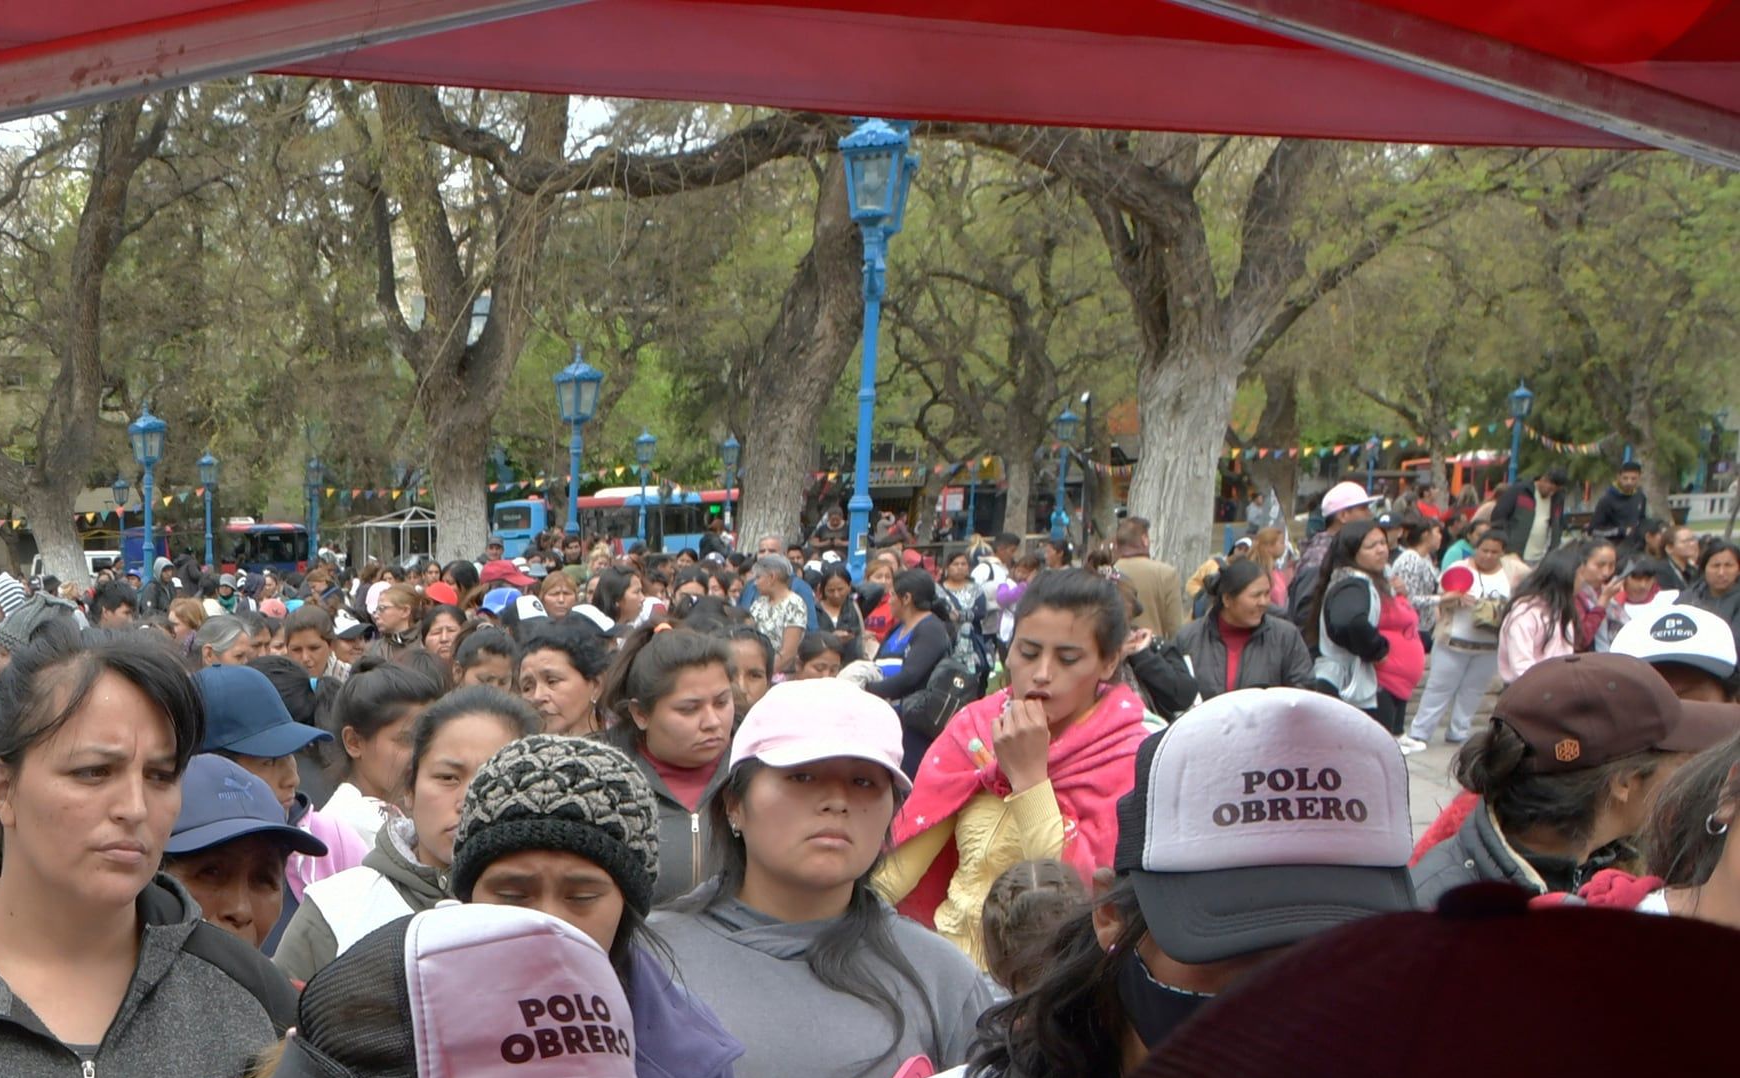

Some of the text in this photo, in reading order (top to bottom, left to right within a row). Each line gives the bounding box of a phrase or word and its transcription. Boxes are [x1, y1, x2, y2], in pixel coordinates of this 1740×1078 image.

[1241, 767, 1342, 795] POLO
[1212, 797, 1368, 827] OBRERO
[517, 993, 612, 1028] POLO
[500, 1024, 630, 1065] OBRERO
